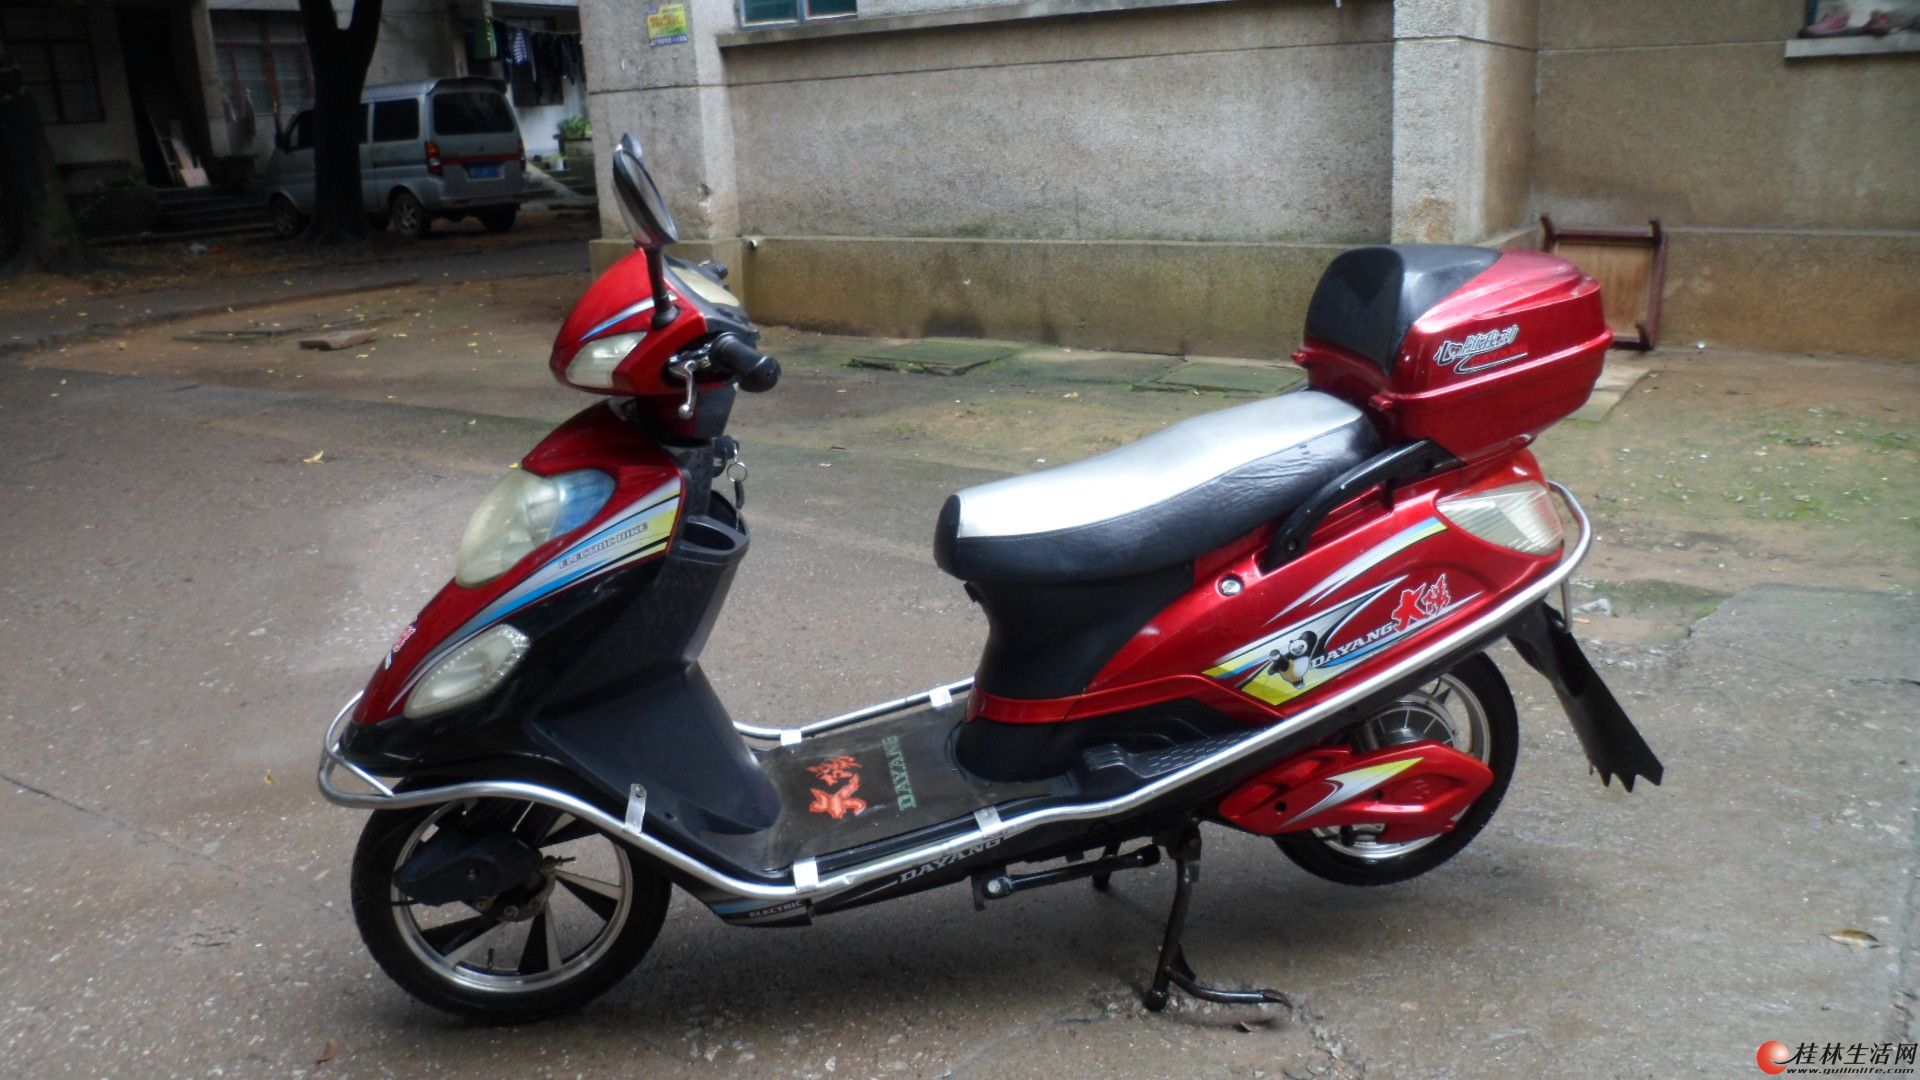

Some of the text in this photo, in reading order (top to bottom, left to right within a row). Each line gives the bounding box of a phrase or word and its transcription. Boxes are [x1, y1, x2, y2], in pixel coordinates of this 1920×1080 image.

[616, 521, 648, 543] BIKE
[1310, 622, 1394, 668] DAYANG
[882, 735, 917, 811] DAYANG
[897, 838, 1002, 884] DAYANG
